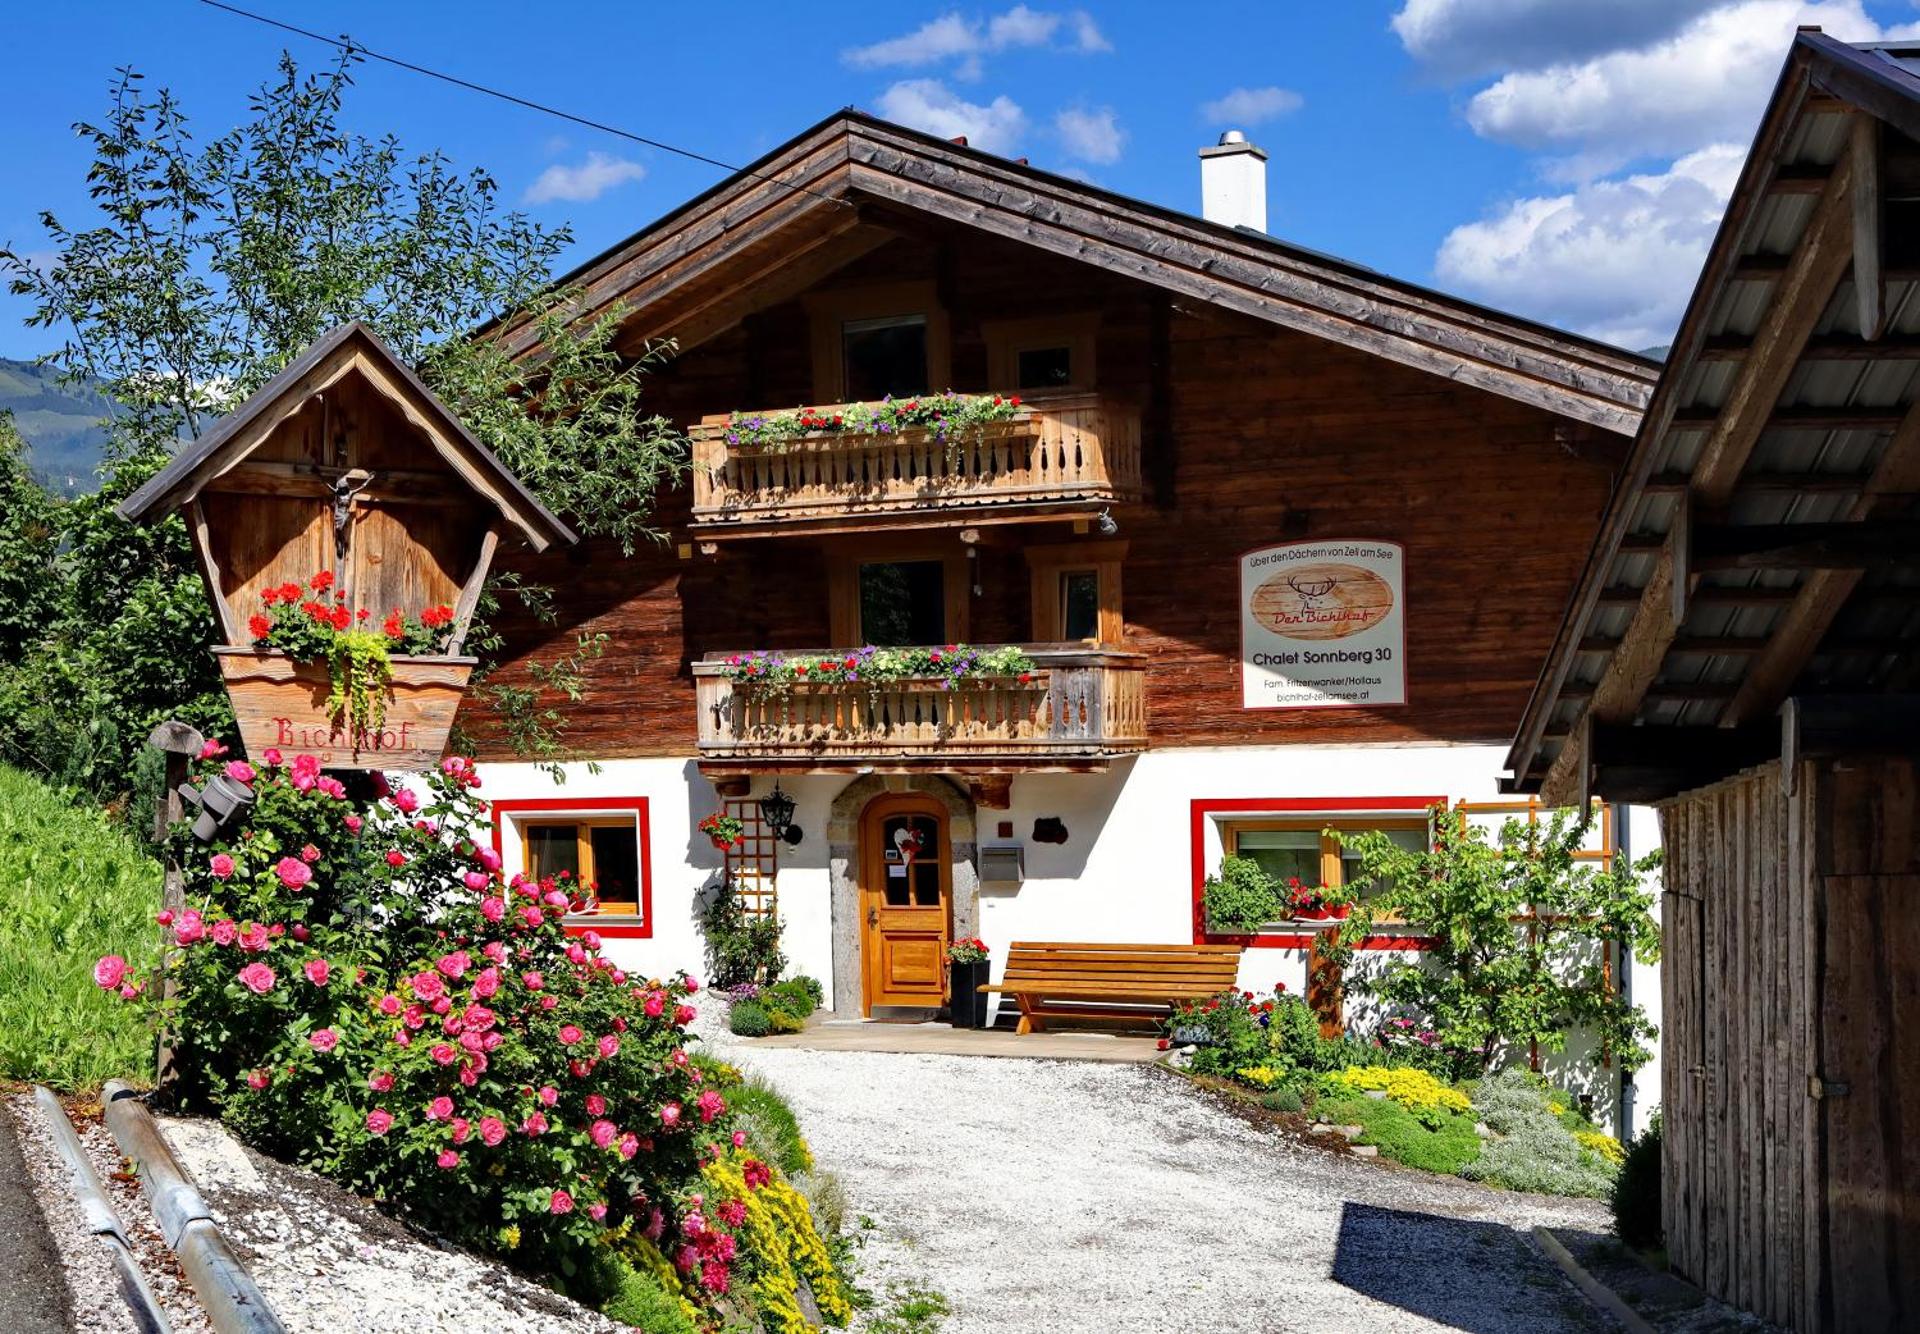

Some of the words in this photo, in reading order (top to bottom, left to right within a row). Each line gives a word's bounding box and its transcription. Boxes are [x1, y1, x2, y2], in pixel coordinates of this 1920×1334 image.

[1250, 556, 1270, 568] über
[1270, 552, 1288, 563] den
[1288, 548, 1327, 560] Dächern
[1327, 548, 1344, 557] von
[1344, 546, 1360, 557] Zell
[1360, 549, 1376, 558] am
[1376, 548, 1393, 559] See
[1272, 611, 1303, 624] Der
[1304, 609, 1376, 623] Bichlhof
[1252, 651, 1299, 666] Chalet
[1304, 650, 1373, 664] Sonnberg
[1375, 647, 1392, 661] 30
